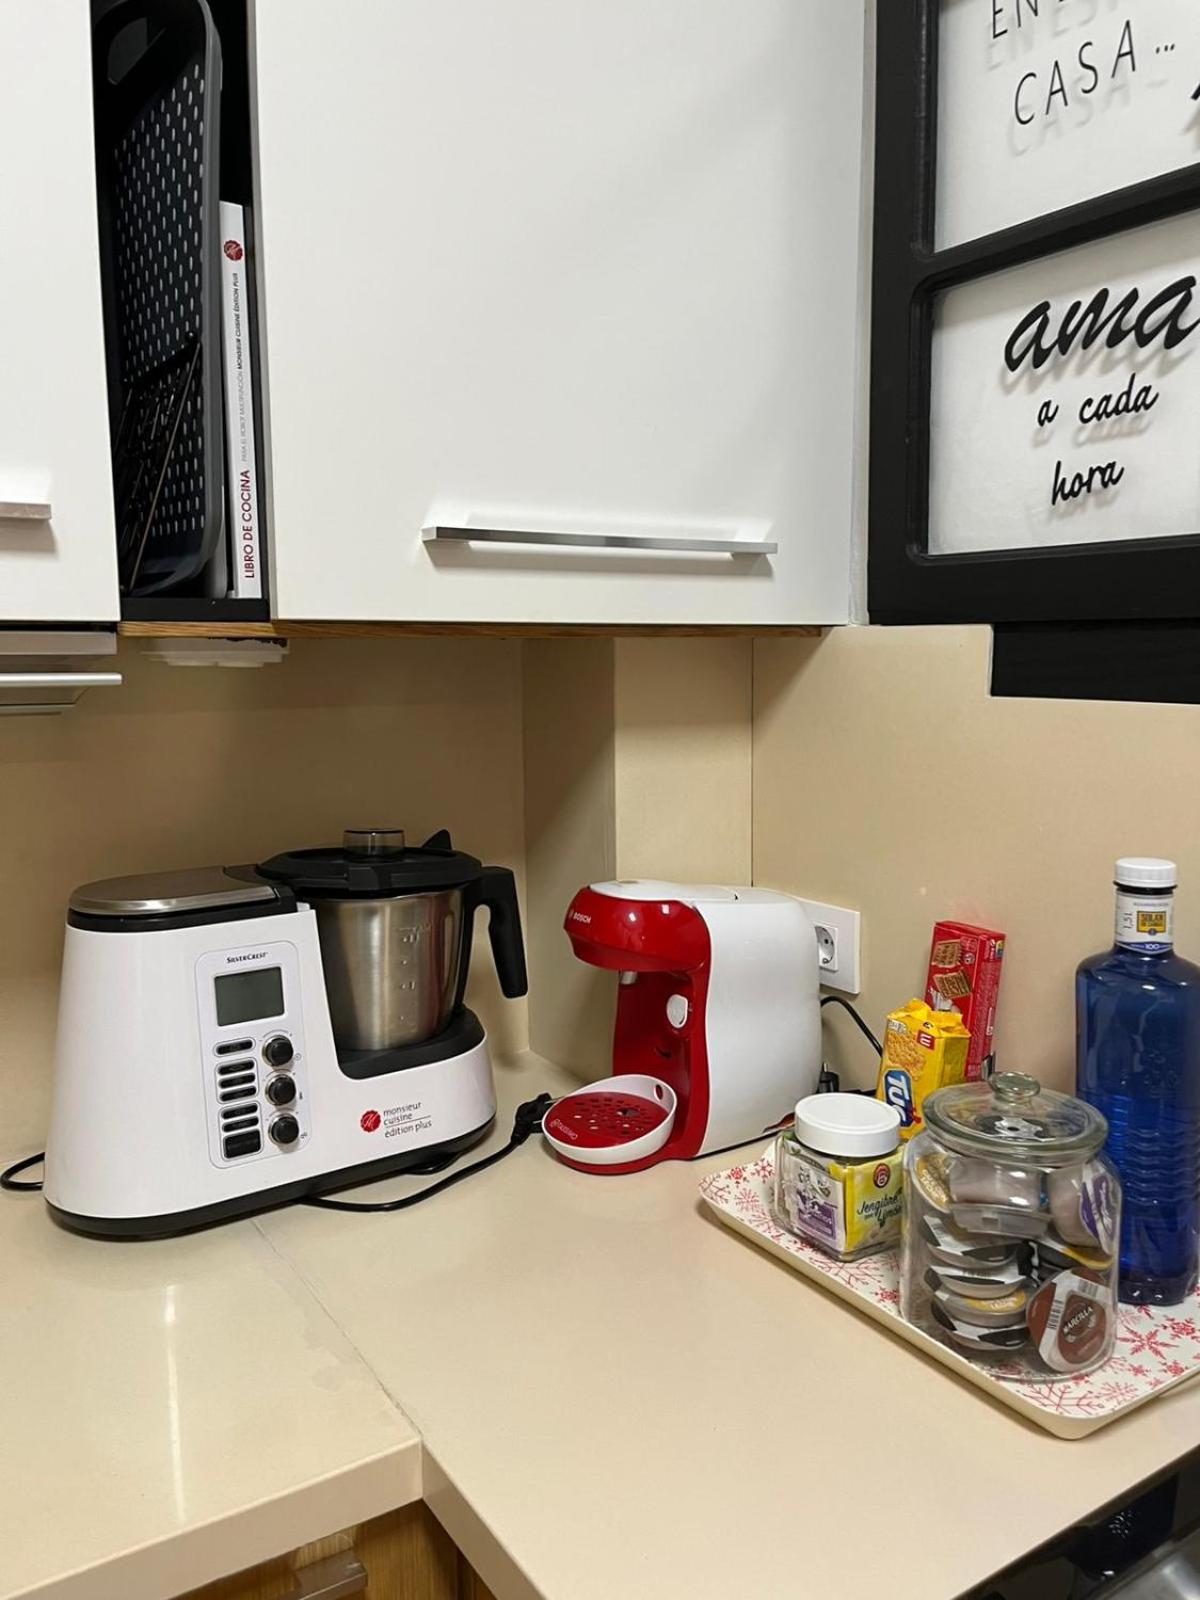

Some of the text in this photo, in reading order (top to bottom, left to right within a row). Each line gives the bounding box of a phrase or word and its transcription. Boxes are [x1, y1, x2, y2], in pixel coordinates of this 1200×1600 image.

[1004, 275, 1200, 372] ama
[1037, 372, 1160, 427] a cada
[1051, 460, 1125, 506] hora
[240, 470, 255, 579] LIBRO DE COCINA
[573, 911, 592, 924] BOSCH
[383, 1102, 422, 1116] monsieur
[383, 1113, 412, 1126] cuisine
[415, 1120, 432, 1133] plus
